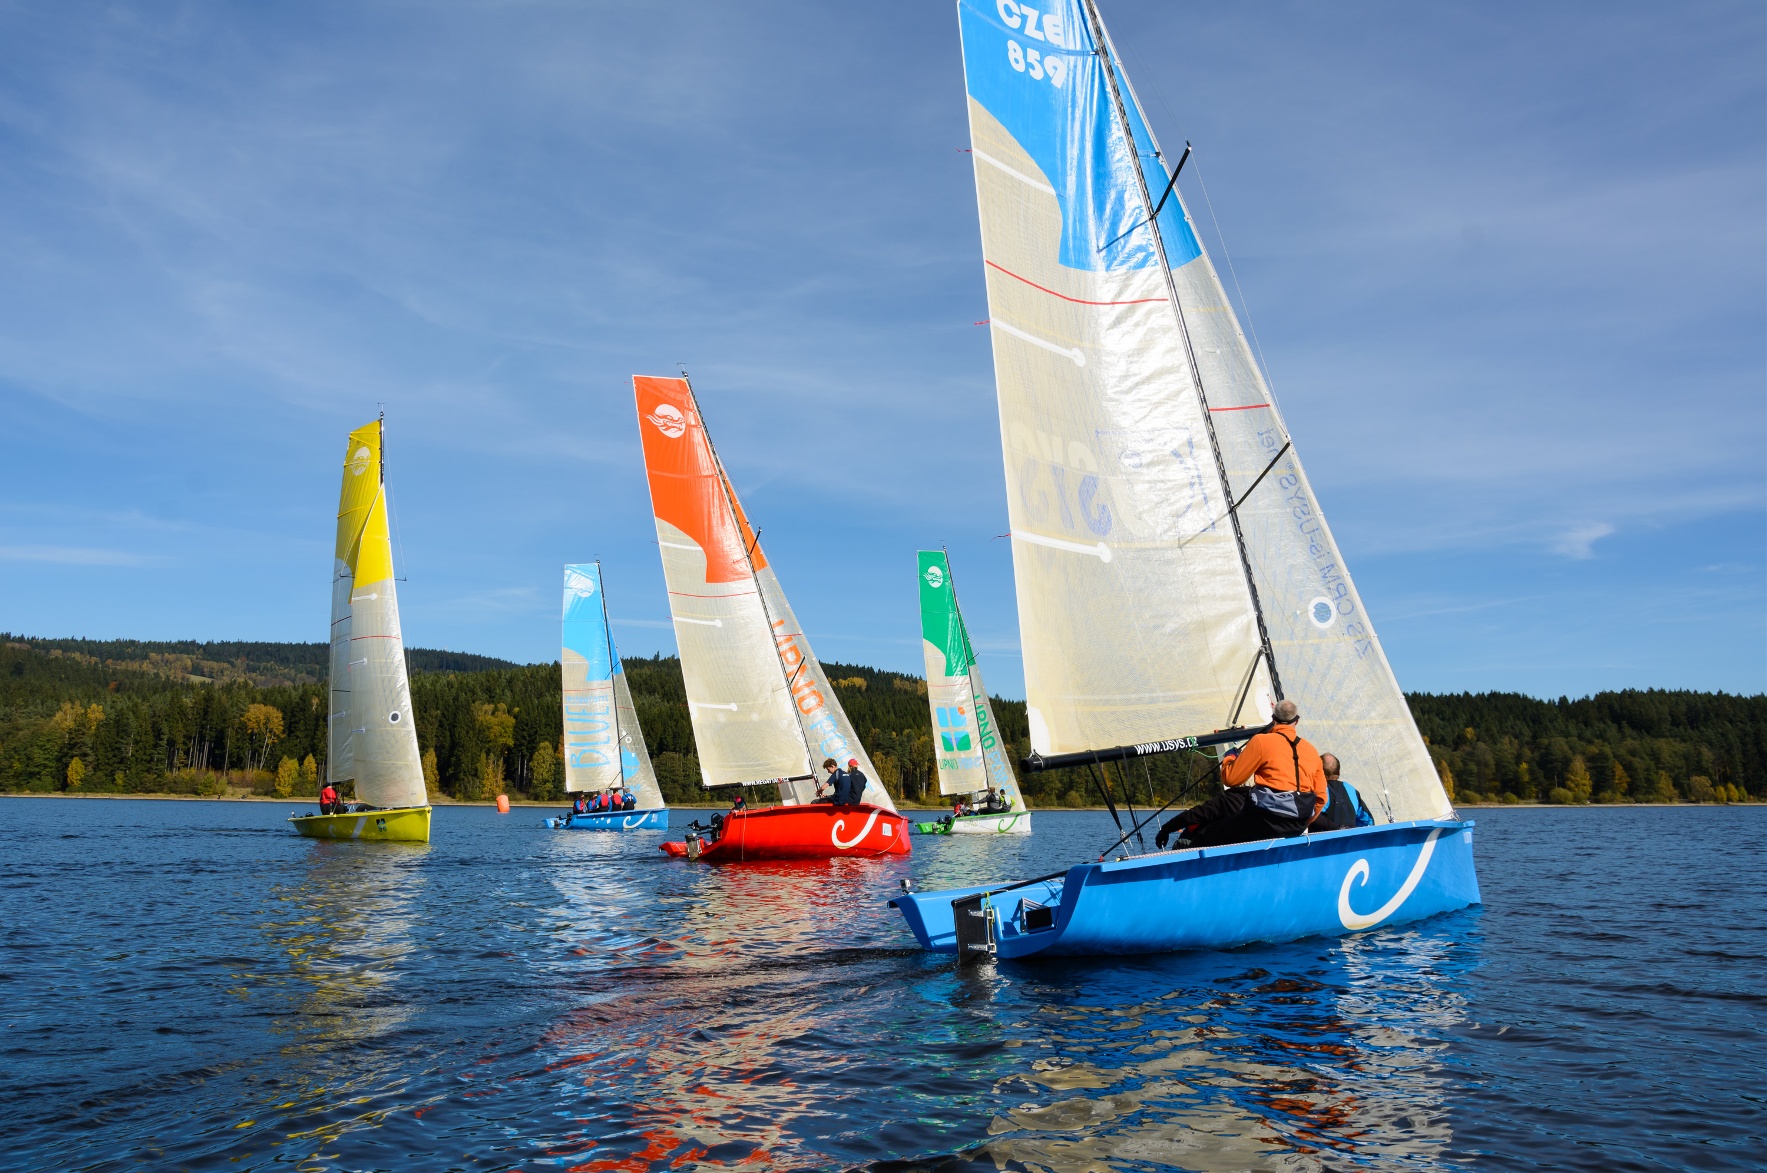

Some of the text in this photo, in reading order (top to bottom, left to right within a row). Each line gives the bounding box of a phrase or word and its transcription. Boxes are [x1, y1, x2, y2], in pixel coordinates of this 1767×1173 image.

[996, 0, 1065, 49] CZE
[1007, 39, 1067, 89] 859
[566, 705, 611, 769] BLUE
